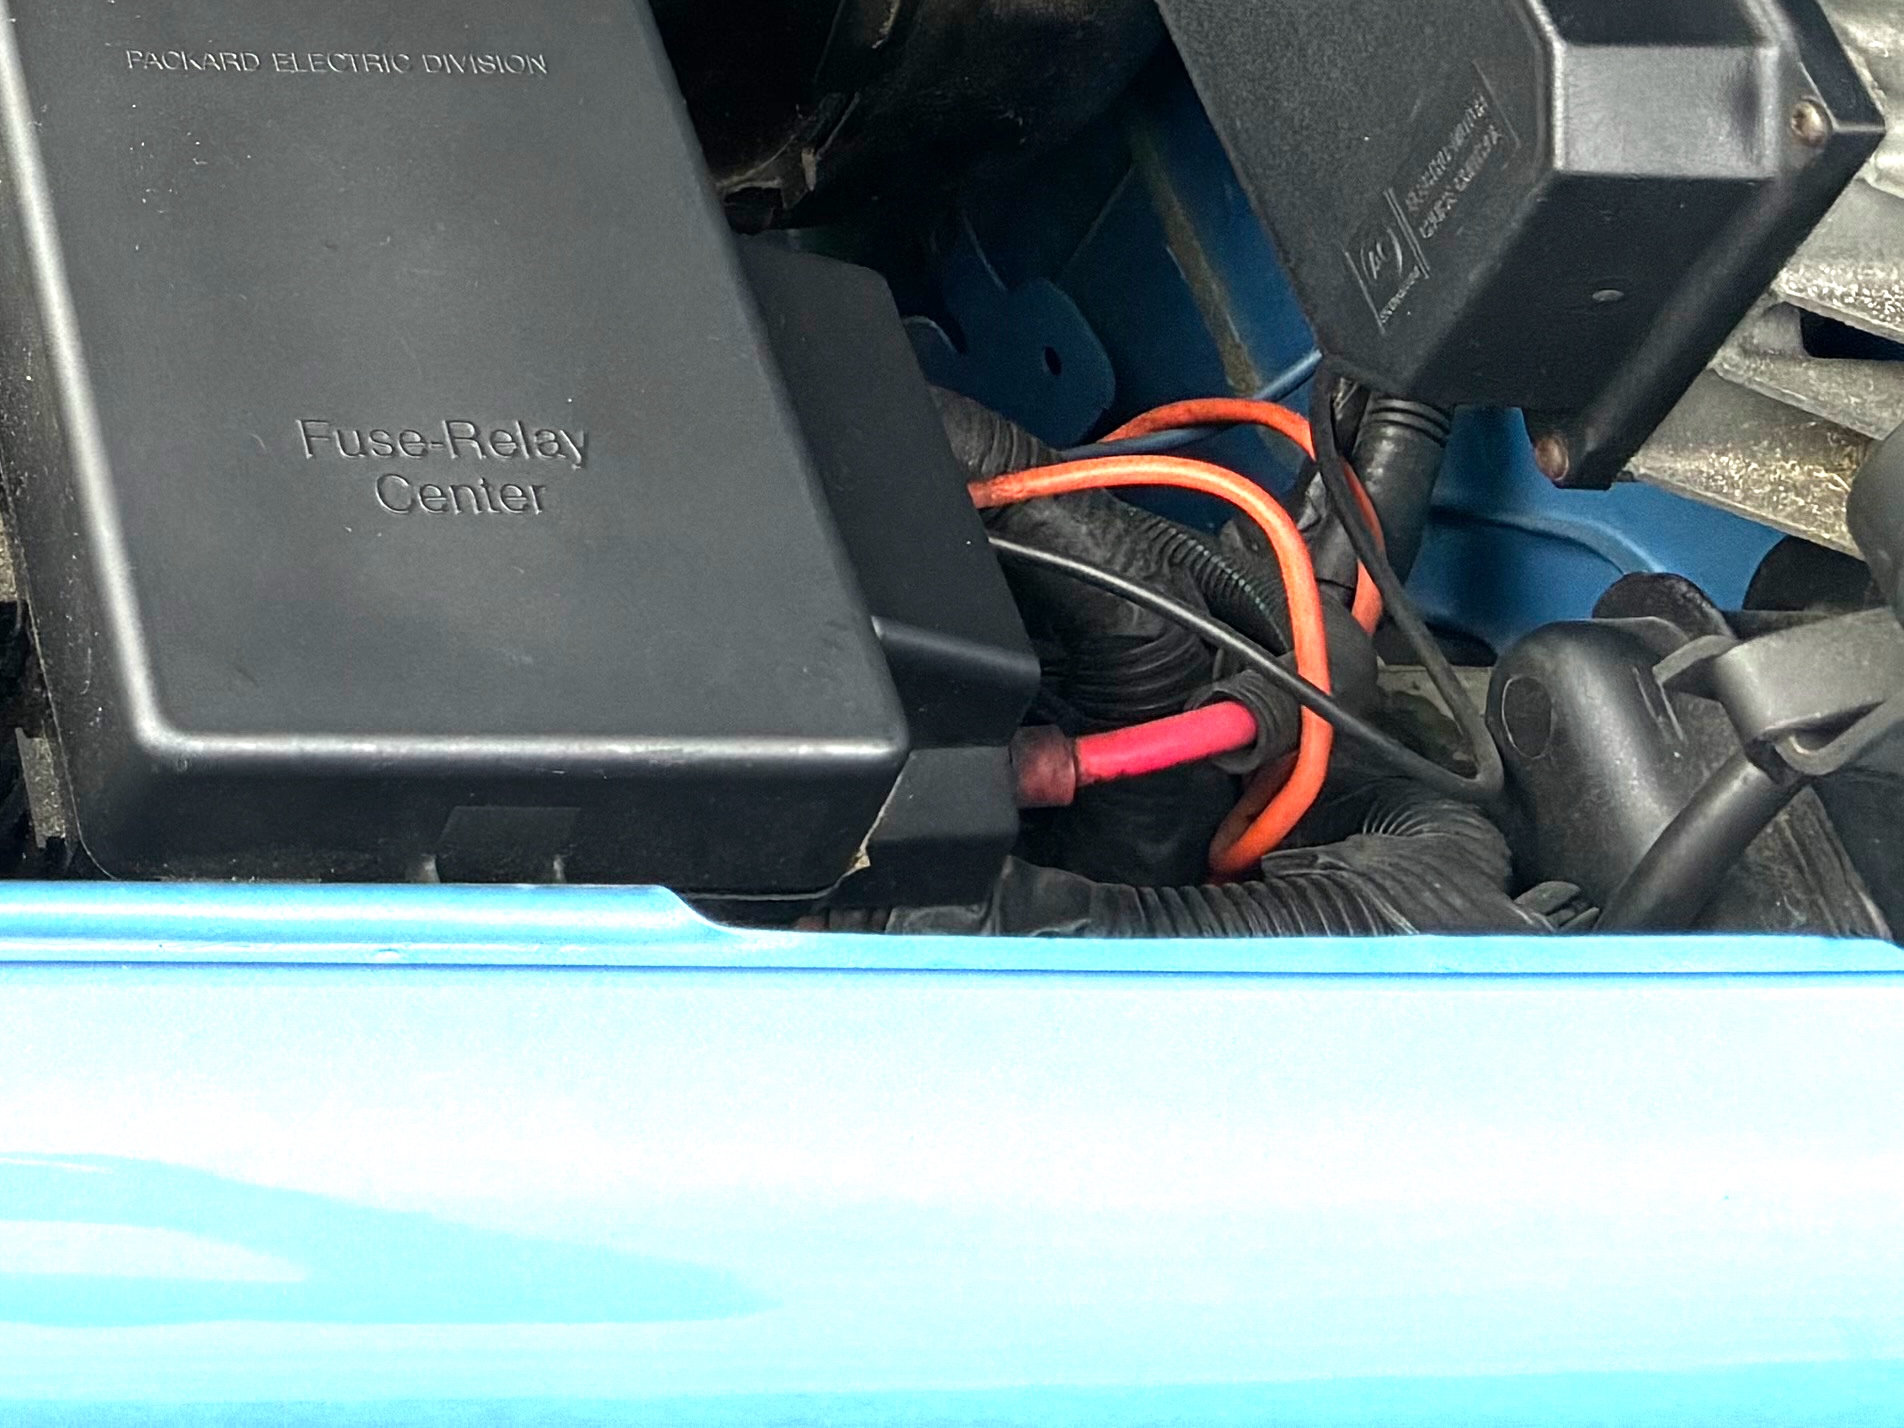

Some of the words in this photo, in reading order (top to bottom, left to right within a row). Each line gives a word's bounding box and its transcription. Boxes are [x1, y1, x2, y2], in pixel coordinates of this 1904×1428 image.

[124, 48, 261, 74] PACKARD
[272, 51, 411, 75] ELECTRIC
[422, 52, 550, 76] DIVISION
[299, 416, 592, 472] Fuse-Relay
[374, 470, 551, 520] Center
